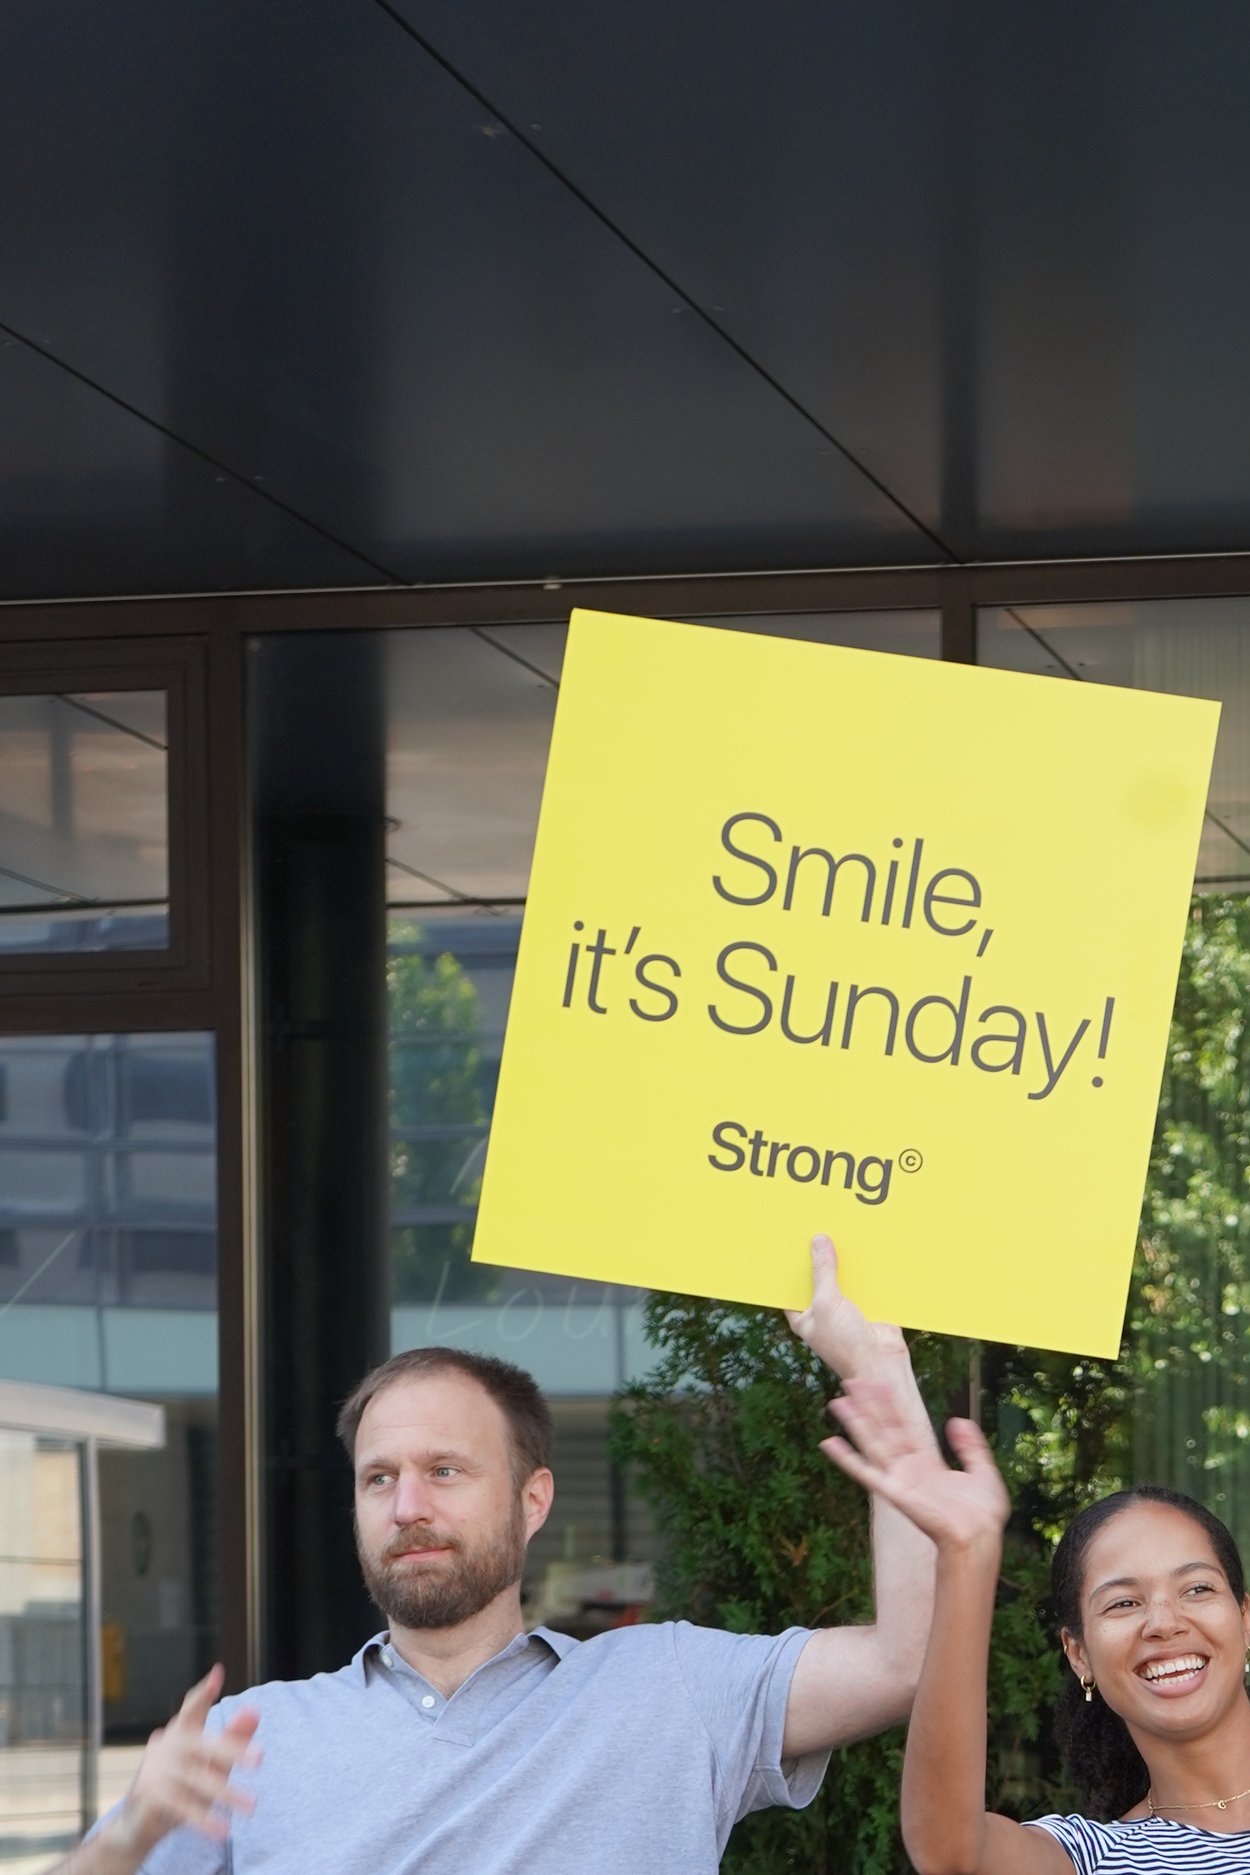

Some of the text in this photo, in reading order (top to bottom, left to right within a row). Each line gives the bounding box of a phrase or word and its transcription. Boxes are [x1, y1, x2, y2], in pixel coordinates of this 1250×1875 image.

[711, 811, 995, 958] Smile,
[561, 920, 1116, 1101] it's Sunday!
